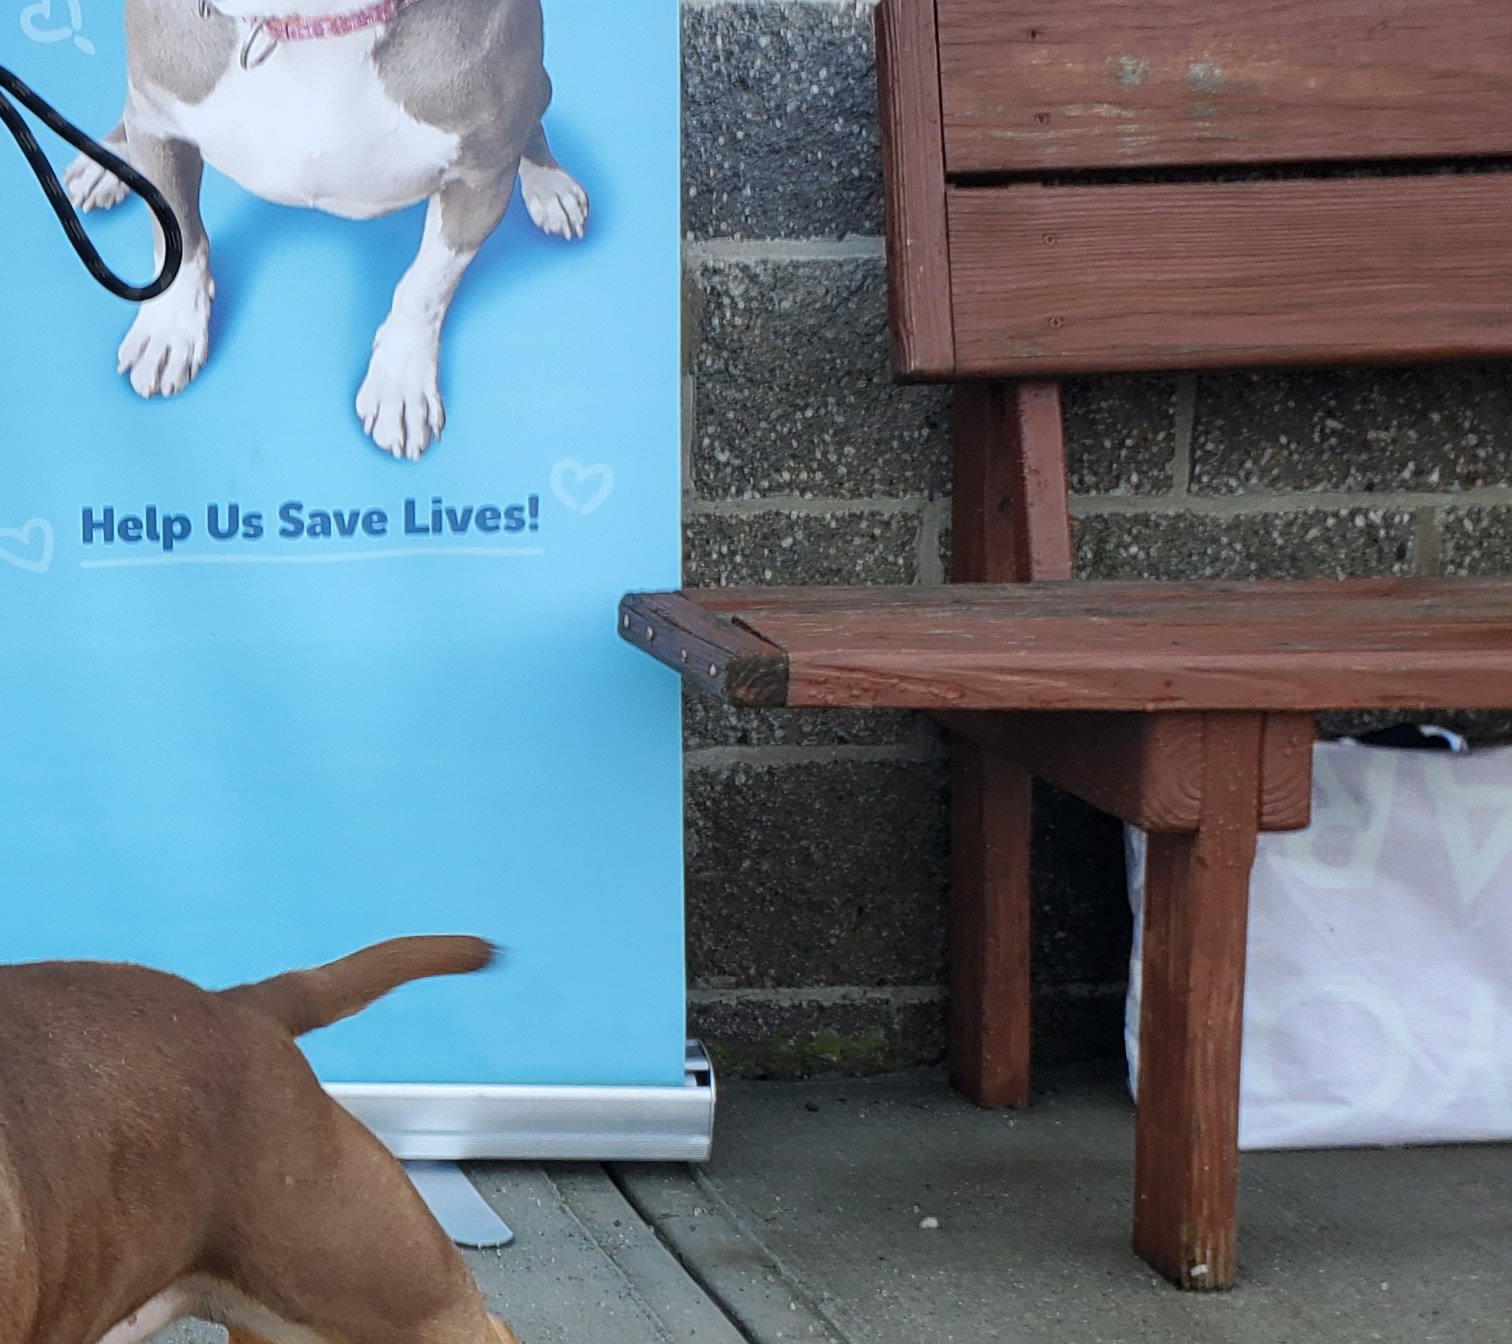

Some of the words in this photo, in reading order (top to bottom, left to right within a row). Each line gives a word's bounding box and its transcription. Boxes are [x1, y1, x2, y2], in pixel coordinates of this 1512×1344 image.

[81, 503, 191, 552] Help
[206, 501, 264, 540] Us
[279, 500, 389, 539] Save
[403, 493, 541, 536] Lives!
